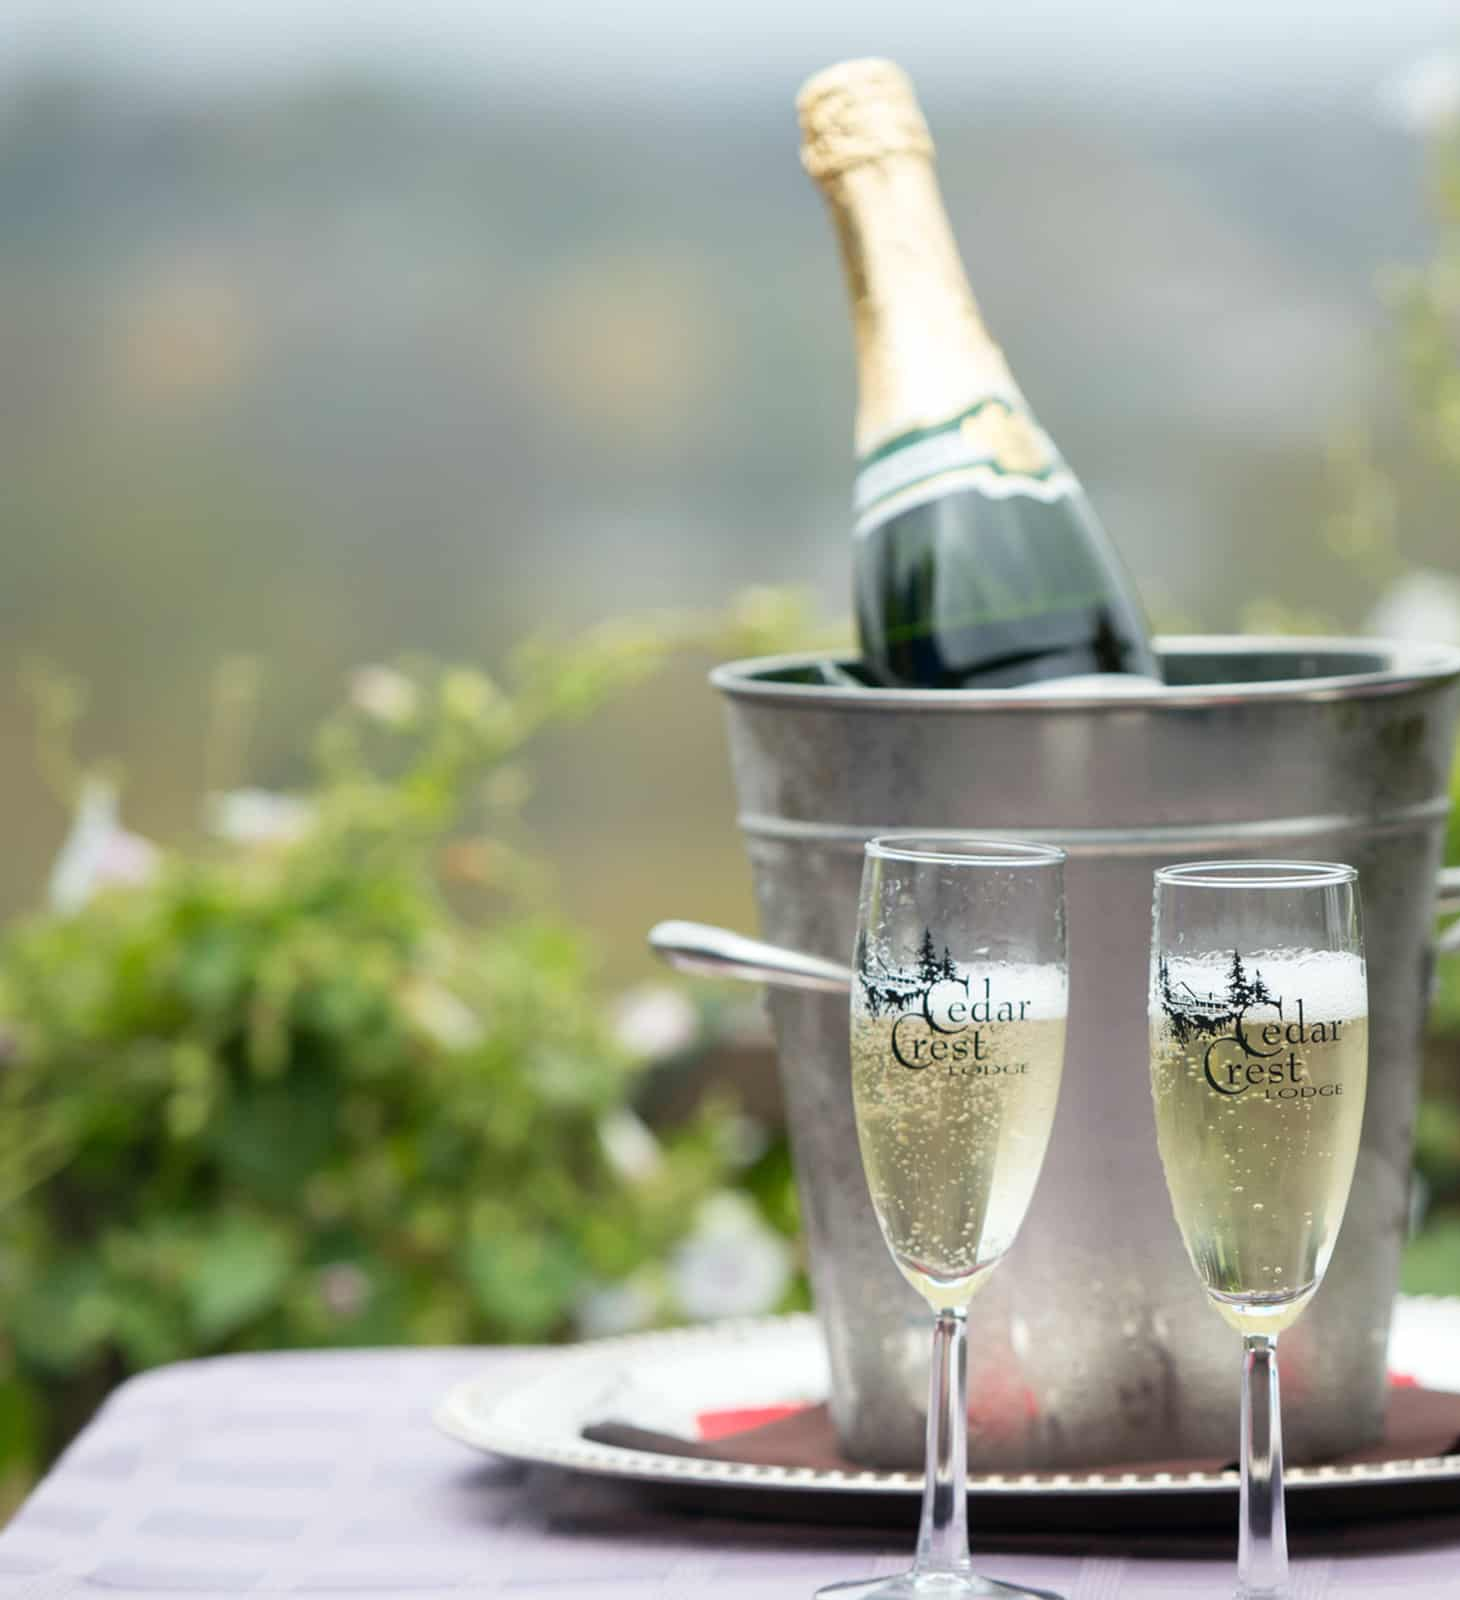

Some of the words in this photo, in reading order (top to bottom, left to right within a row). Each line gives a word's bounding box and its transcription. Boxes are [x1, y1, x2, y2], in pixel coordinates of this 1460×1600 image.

[923, 975, 1031, 1034] Cedar
[1236, 996, 1343, 1057] Cedar
[892, 1013, 988, 1069] Crest
[949, 1063, 1031, 1076] LODGE
[1204, 1036, 1303, 1095] Crest
[1265, 1084, 1343, 1099] LODGE
